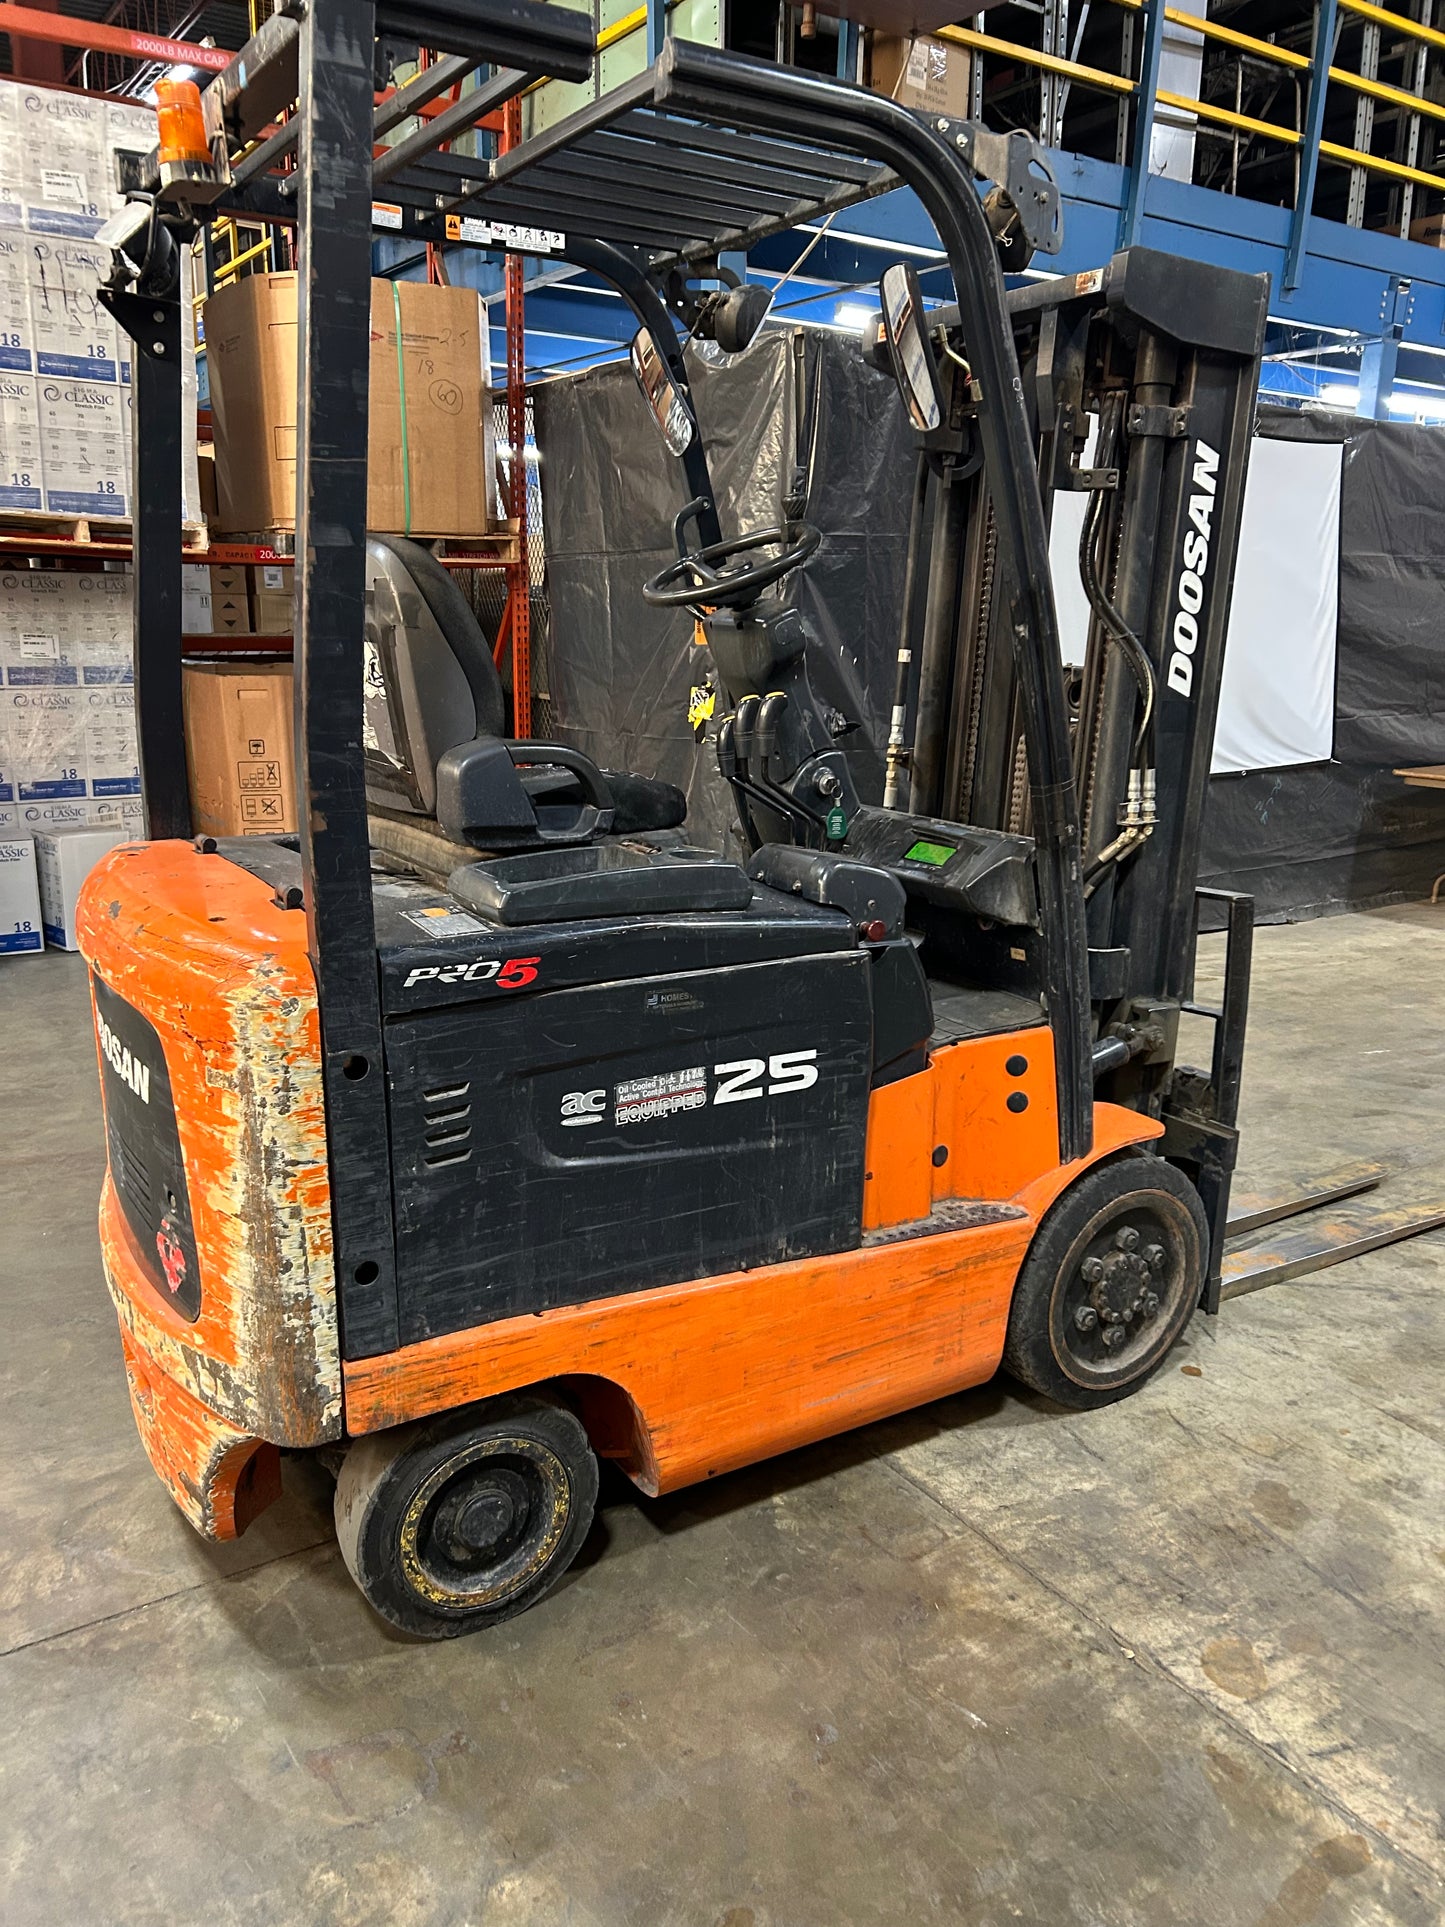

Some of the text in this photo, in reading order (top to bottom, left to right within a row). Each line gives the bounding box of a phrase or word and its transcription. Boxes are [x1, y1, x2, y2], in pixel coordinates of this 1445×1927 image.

[136, 39, 225, 66] 2000LB MAX CAP
[46, 102, 97, 121] CLASSIC
[1, 332, 21, 348] 18
[87, 344, 107, 359] 18
[418, 359, 434, 375] 18
[64, 391, 114, 406] CLASSIC
[438, 384, 457, 406] 60
[11, 473, 31, 487] 18
[97, 481, 116, 494] 18
[1167, 439, 1221, 698] DOOSAN
[21, 580, 65, 589] CLASSIC
[61, 769, 77, 780] 18
[43, 808, 86, 819] CLASSIC
[14, 921, 32, 933] 18
[55, 916, 63, 928] 18
[403, 957, 542, 989] PRO5
[713, 1049, 819, 1105] 25
[618, 1085, 629, 1095] Oil
[632, 1080, 656, 1092] Cooled
[561, 1090, 606, 1115] ac
[619, 1093, 639, 1103] Active
[616, 1090, 707, 1125] EQUIPPED
